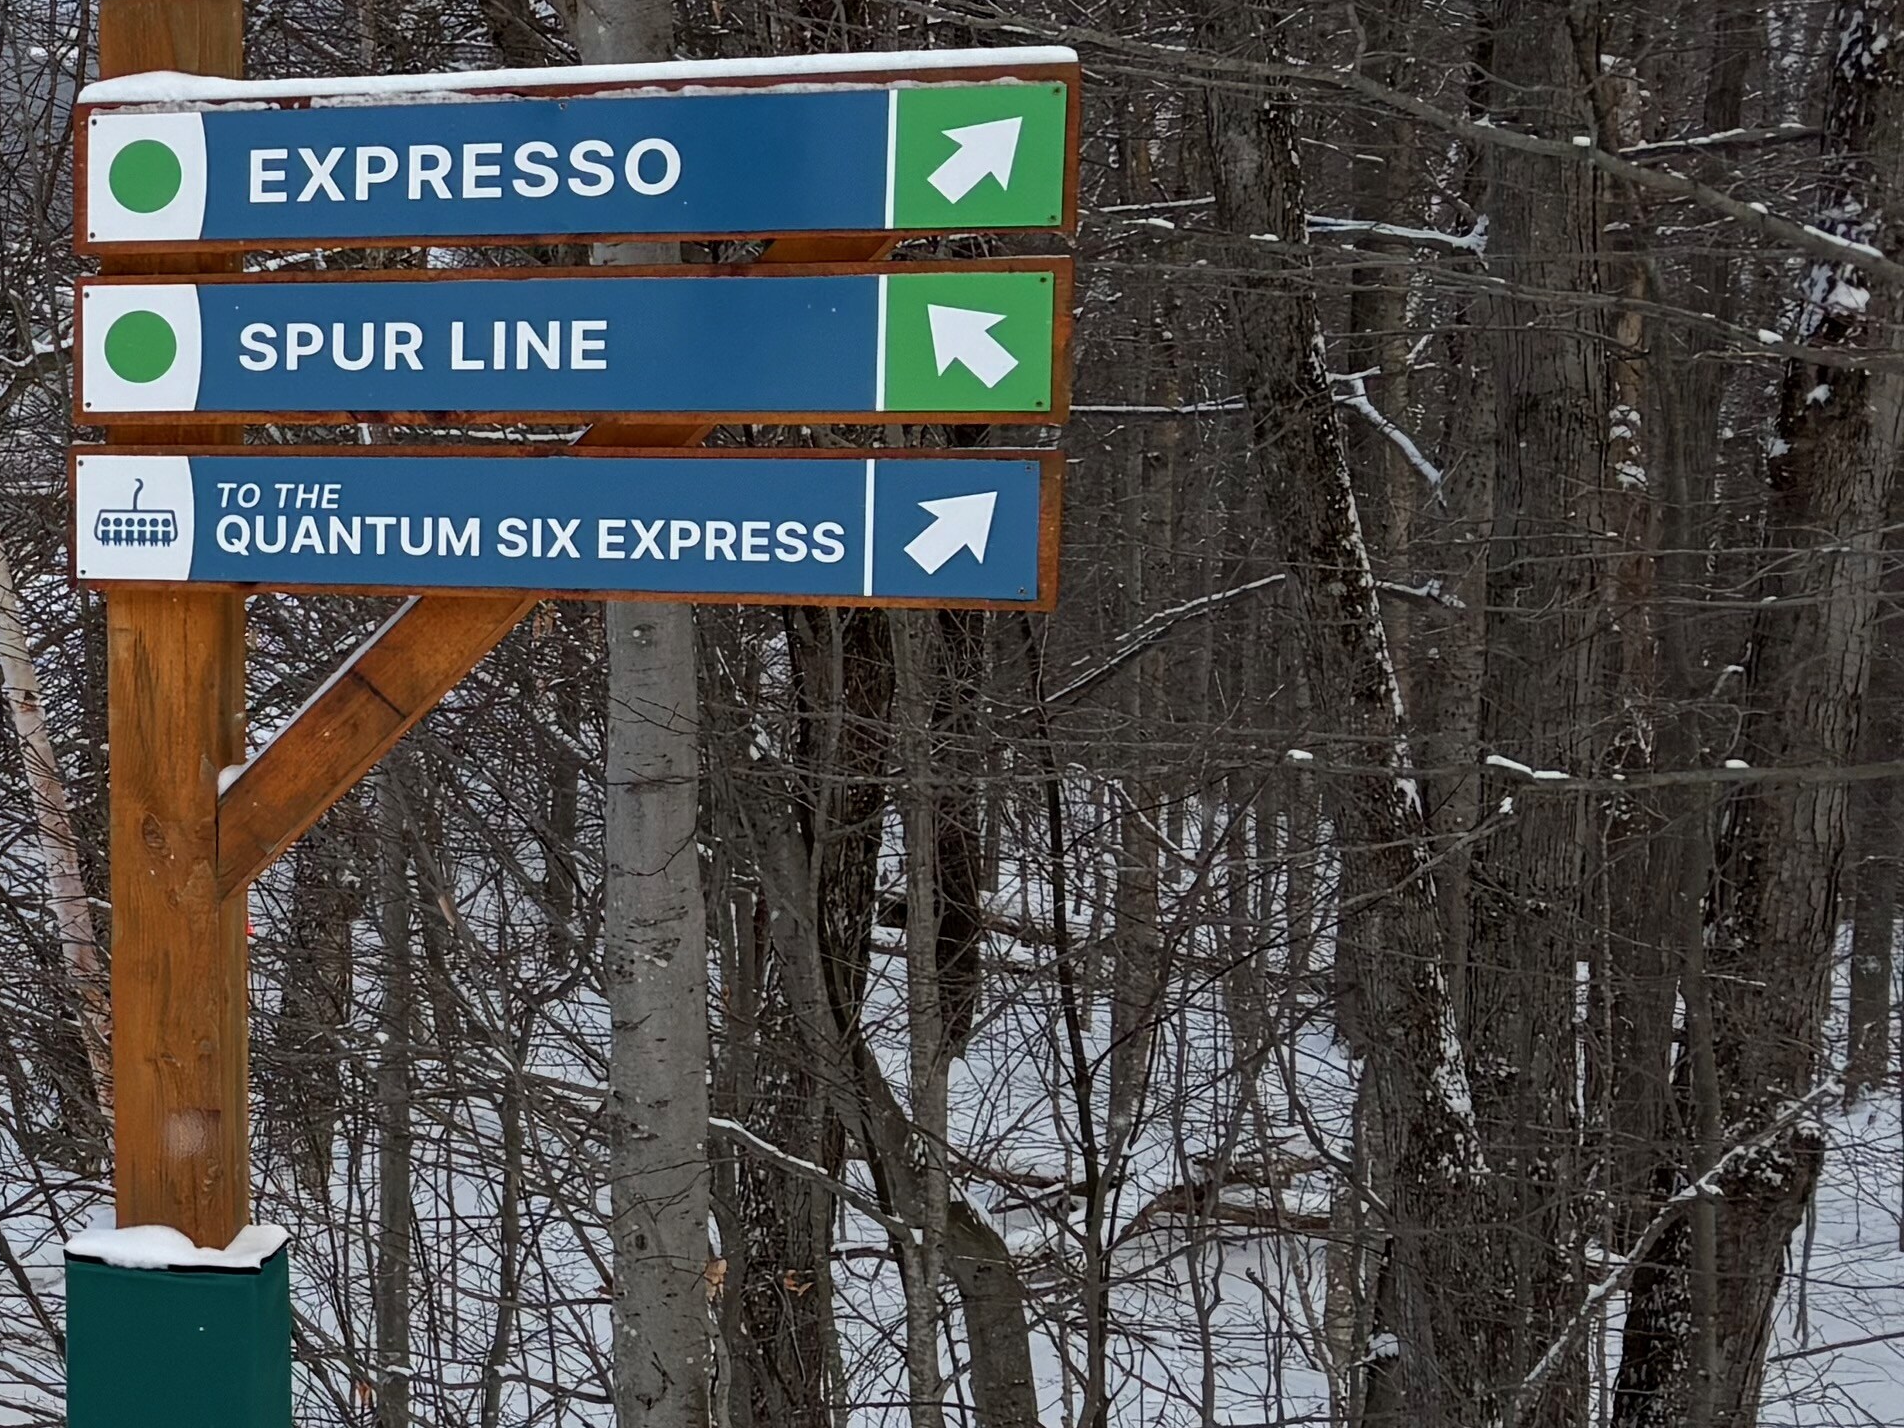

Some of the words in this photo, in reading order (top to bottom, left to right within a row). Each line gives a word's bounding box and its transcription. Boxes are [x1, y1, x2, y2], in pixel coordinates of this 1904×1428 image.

[248, 137, 682, 204] EXPRESSO
[238, 321, 425, 372] SPUR
[450, 319, 608, 371] LINE
[216, 482, 262, 509] TO
[273, 482, 343, 510] THE
[215, 513, 481, 558] QUANTUM
[496, 516, 582, 559] SIX
[597, 518, 846, 564] EXPRESS
